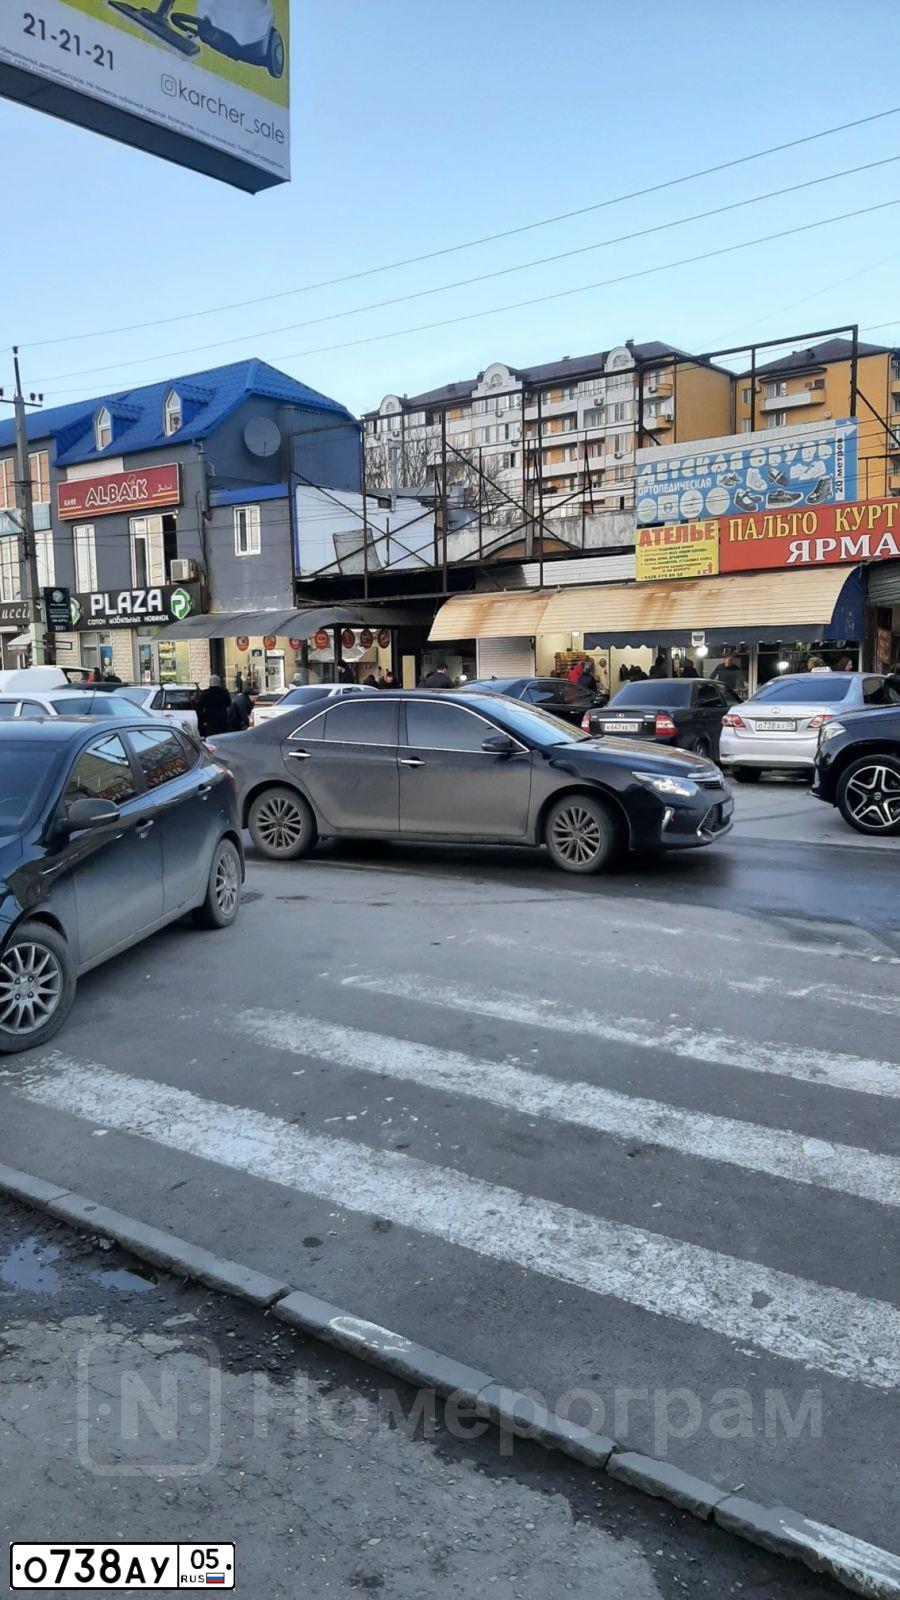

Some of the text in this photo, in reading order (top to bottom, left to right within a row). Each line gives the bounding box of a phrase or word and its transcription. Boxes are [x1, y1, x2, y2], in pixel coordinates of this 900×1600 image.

[22, 13, 114, 71] 21-21-21
[178, 79, 285, 144] karcher_sale
[637, 477, 712, 496] ОРТОПЕДИЧЕСКАЯ
[835, 480, 844, 494] 20
[639, 521, 715, 547] АТЕЛЬЕ
[728, 502, 899, 542] ПАЛЬТО КУРТ
[786, 531, 900, 564] ЯРМА
[90, 588, 163, 616] PLAZA
